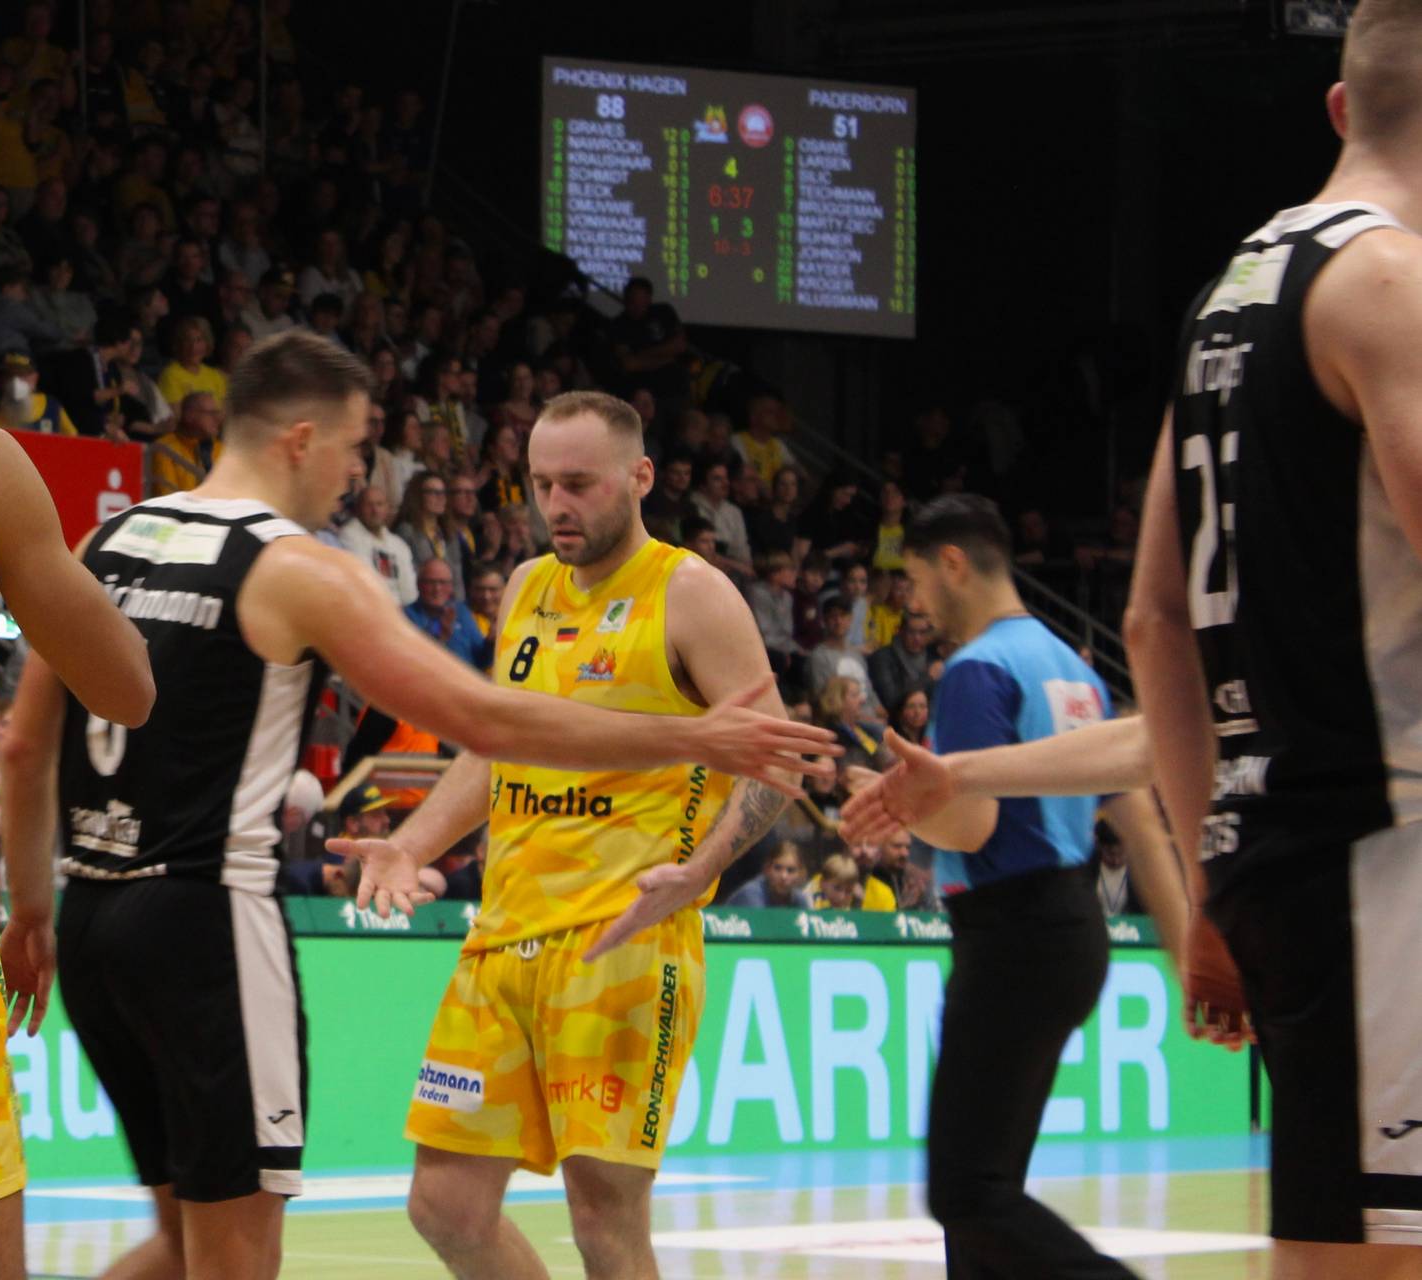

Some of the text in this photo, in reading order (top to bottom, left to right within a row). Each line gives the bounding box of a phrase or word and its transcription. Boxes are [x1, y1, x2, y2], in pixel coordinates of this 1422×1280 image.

[553, 68, 687, 96] PHOENIX HAGEN
[596, 95, 625, 119] 88
[809, 89, 906, 113] PADERBORN
[569, 119, 625, 138] GRAVES
[833, 114, 859, 139] 51
[569, 167, 628, 184] SCHMIDT
[724, 157, 738, 178] 4
[708, 184, 755, 209] 6:37
[799, 184, 876, 203] TEICHMANN
[102, 574, 223, 630] ichmann
[509, 636, 540, 682] 8
[507, 782, 613, 818] Thalia
[809, 914, 858, 939] Thalia
